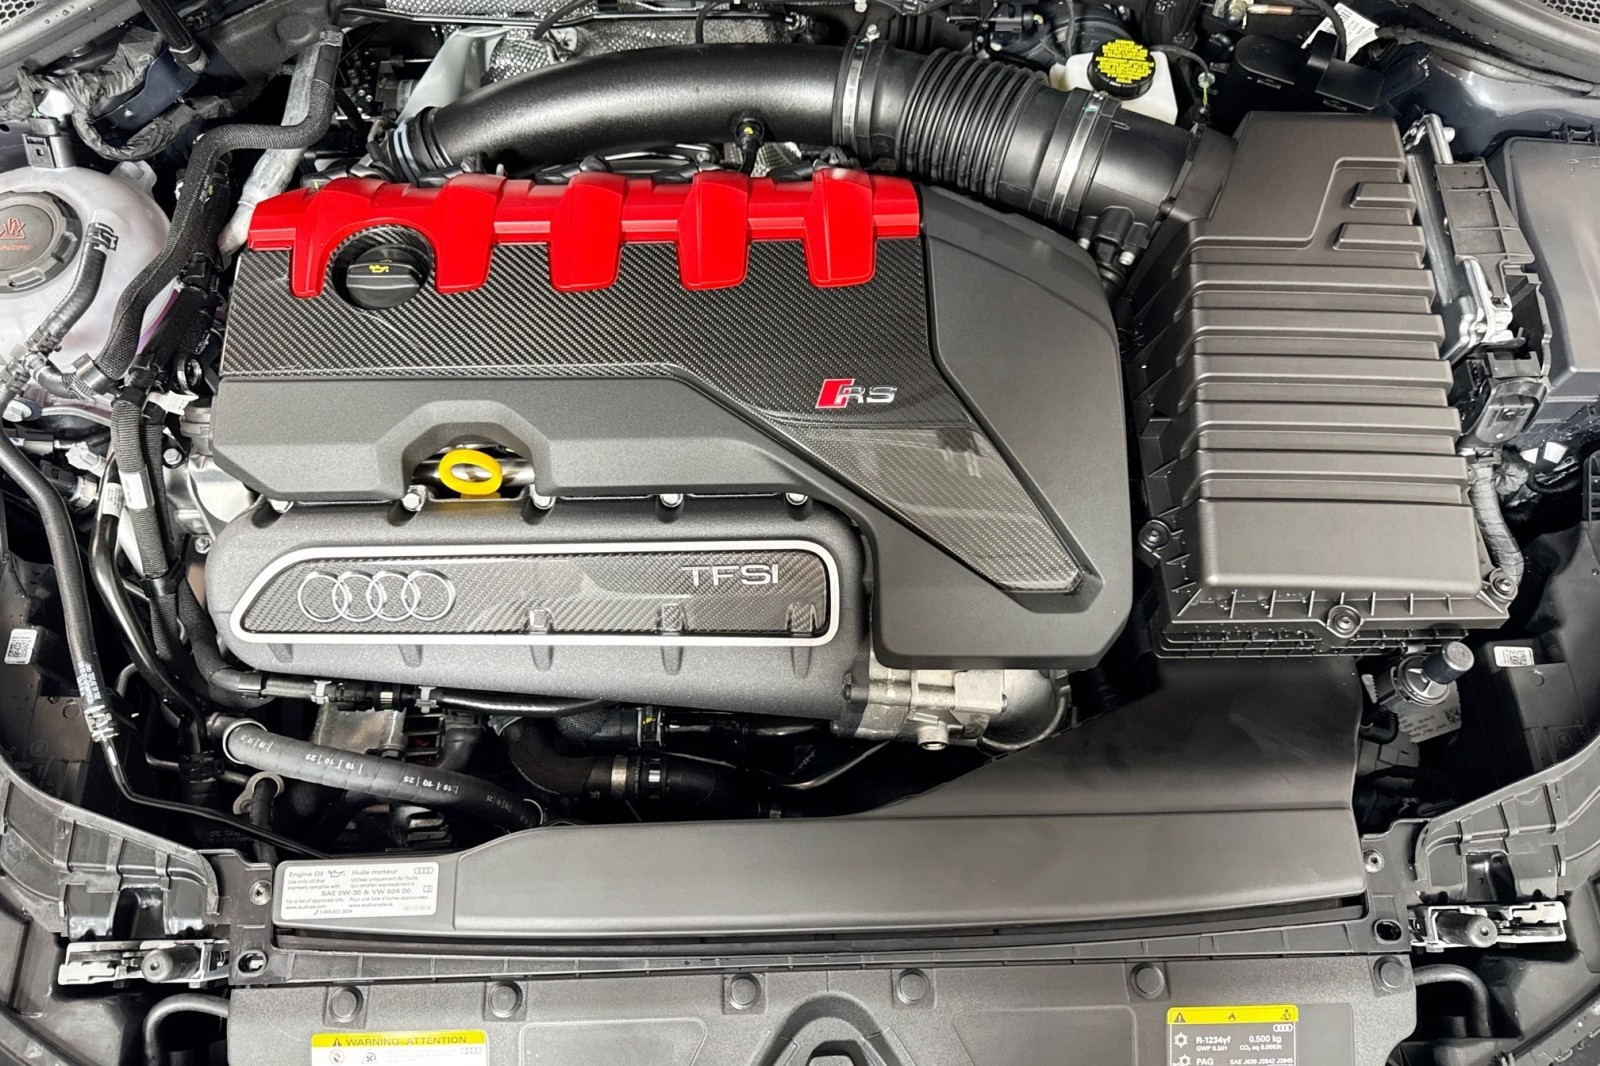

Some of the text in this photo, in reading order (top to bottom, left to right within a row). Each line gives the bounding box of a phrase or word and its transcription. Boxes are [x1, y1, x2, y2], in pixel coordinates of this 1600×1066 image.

[834, 385, 897, 404] RS
[682, 563, 778, 586] TFSI
[305, 754, 355, 771] 19 10 25
[403, 775, 415, 784] 25
[443, 784, 452, 792] 19
[347, 1036, 467, 1047] WARNING ATTENTION
[1196, 1036, 1231, 1045] R-1234yf
[1249, 1035, 1282, 1044] 0.500 kg
[1196, 1058, 1214, 1066] PAG
